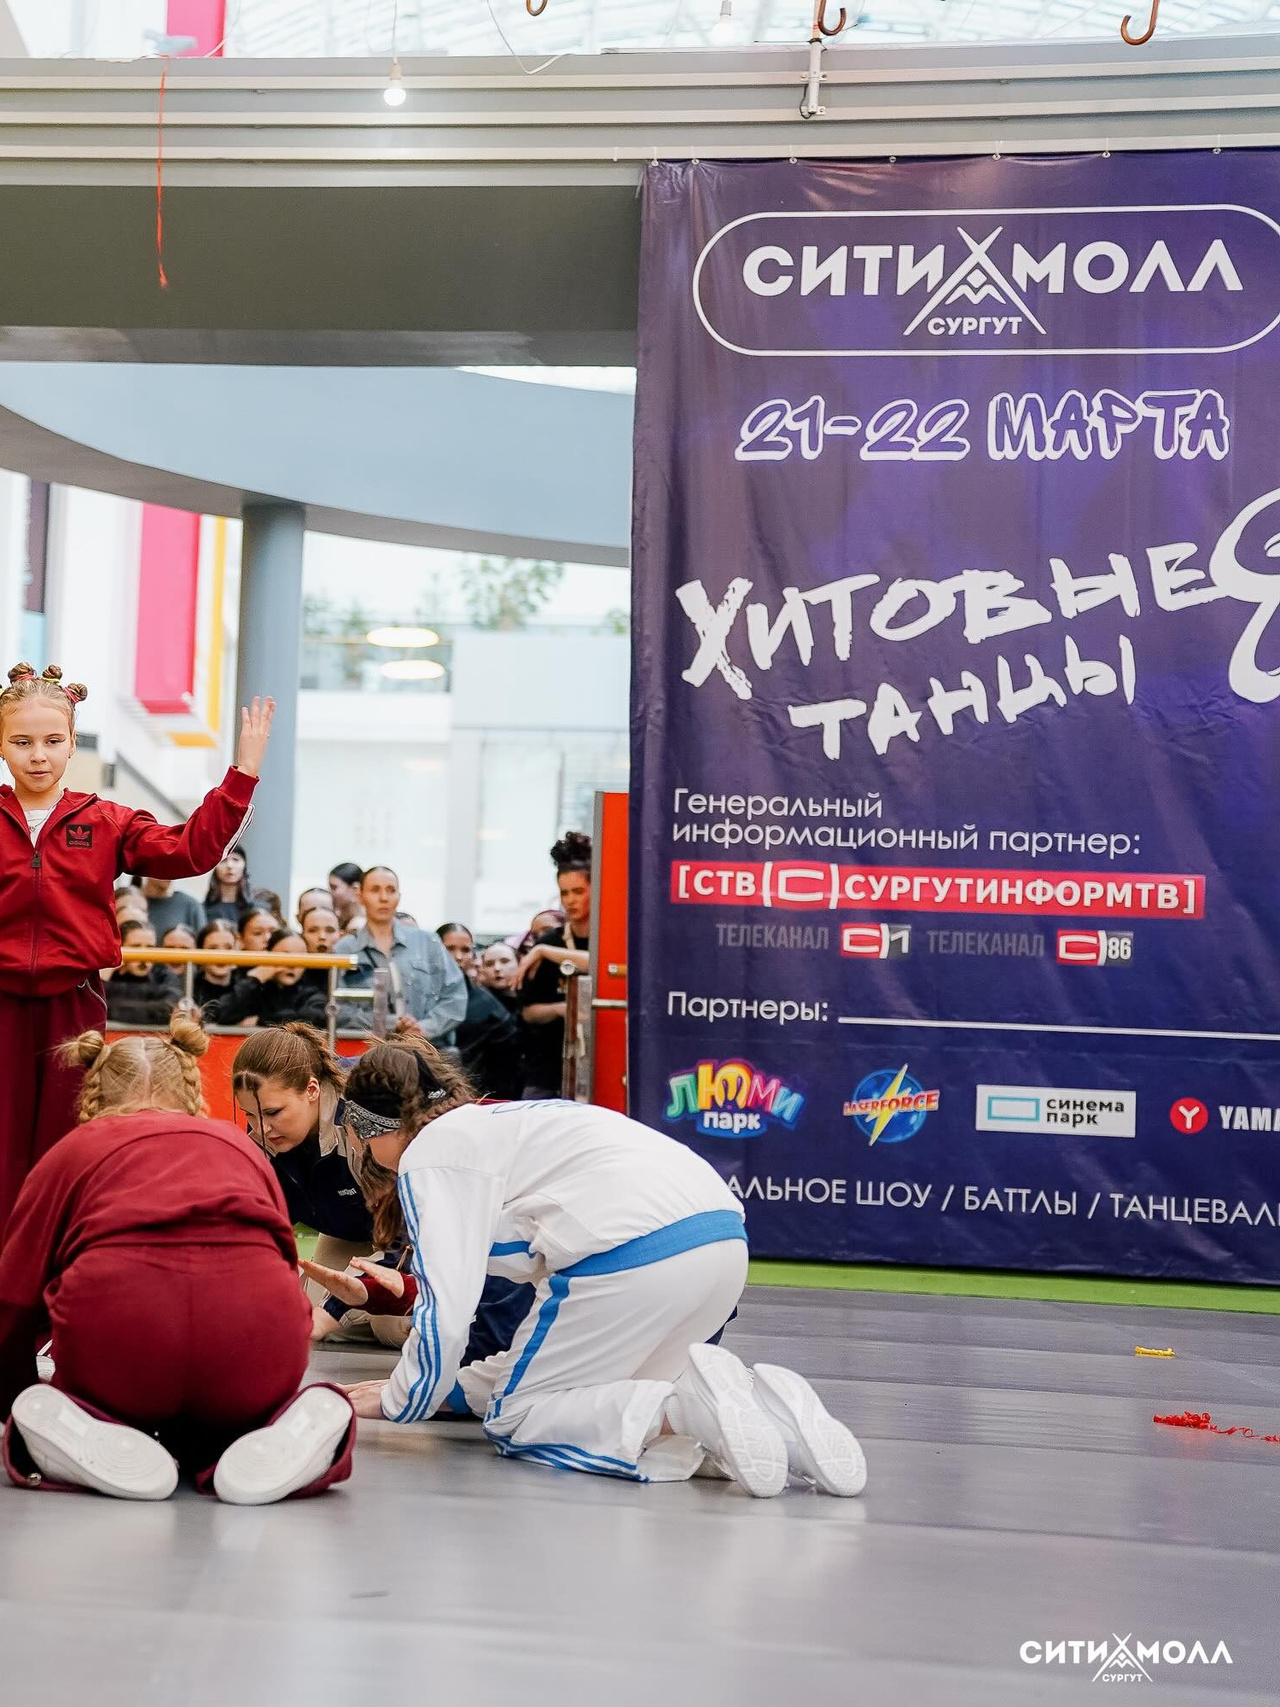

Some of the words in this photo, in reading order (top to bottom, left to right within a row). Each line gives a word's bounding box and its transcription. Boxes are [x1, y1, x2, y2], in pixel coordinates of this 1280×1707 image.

[927, 315, 1023, 336] СУРГУТ
[734, 394, 971, 462] 21-22
[987, 389, 1230, 461] МАРТА
[675, 542, 1224, 700] ХИТОВЫЕ
[789, 635, 1135, 760] ТАНЦЫ
[674, 788, 883, 820] Генеральный
[672, 818, 978, 851] информационный
[989, 830, 1140, 860] партнер:
[715, 923, 830, 950] ТЕЛЕКАНАЛ
[926, 930, 1045, 957] ТЕЛЕКАНАЛ
[668, 991, 829, 1026] Партнеры:
[666, 1063, 804, 1121] ЛЮМИ
[1046, 1098, 1125, 1113] синема
[703, 1110, 761, 1134] парк
[1046, 1111, 1098, 1128] парк
[856, 1180, 933, 1208] ШОУ
[964, 1186, 1077, 1216] БАТТЛЫ
[1110, 1193, 1280, 1228] ТАНЦЕВАЛ
